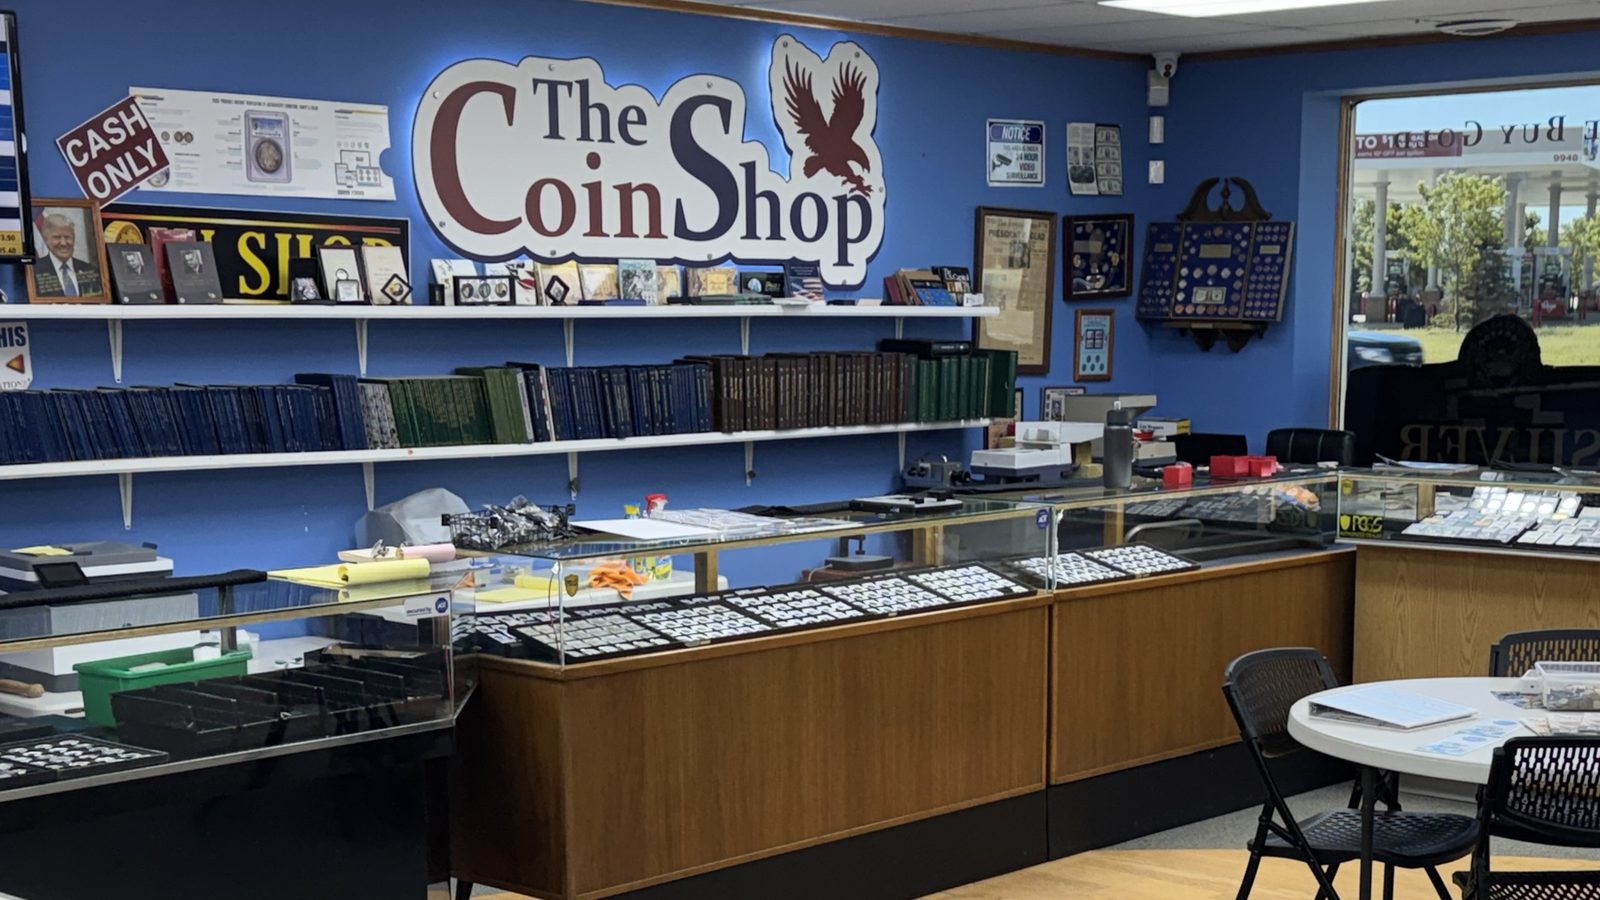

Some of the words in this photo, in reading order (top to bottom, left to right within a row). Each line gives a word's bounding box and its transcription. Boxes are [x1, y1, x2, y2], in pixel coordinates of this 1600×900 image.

[532, 77, 648, 146] The
[66, 103, 147, 167] CASH
[1002, 126, 1031, 141] NOTICE
[1356, 136, 1377, 149] TO
[87, 138, 157, 199] ONLY
[430, 80, 668, 239] Coin
[669, 95, 872, 267] Shop
[1019, 162, 1036, 171] VIDEO
[1352, 515, 1383, 533] PCGS
